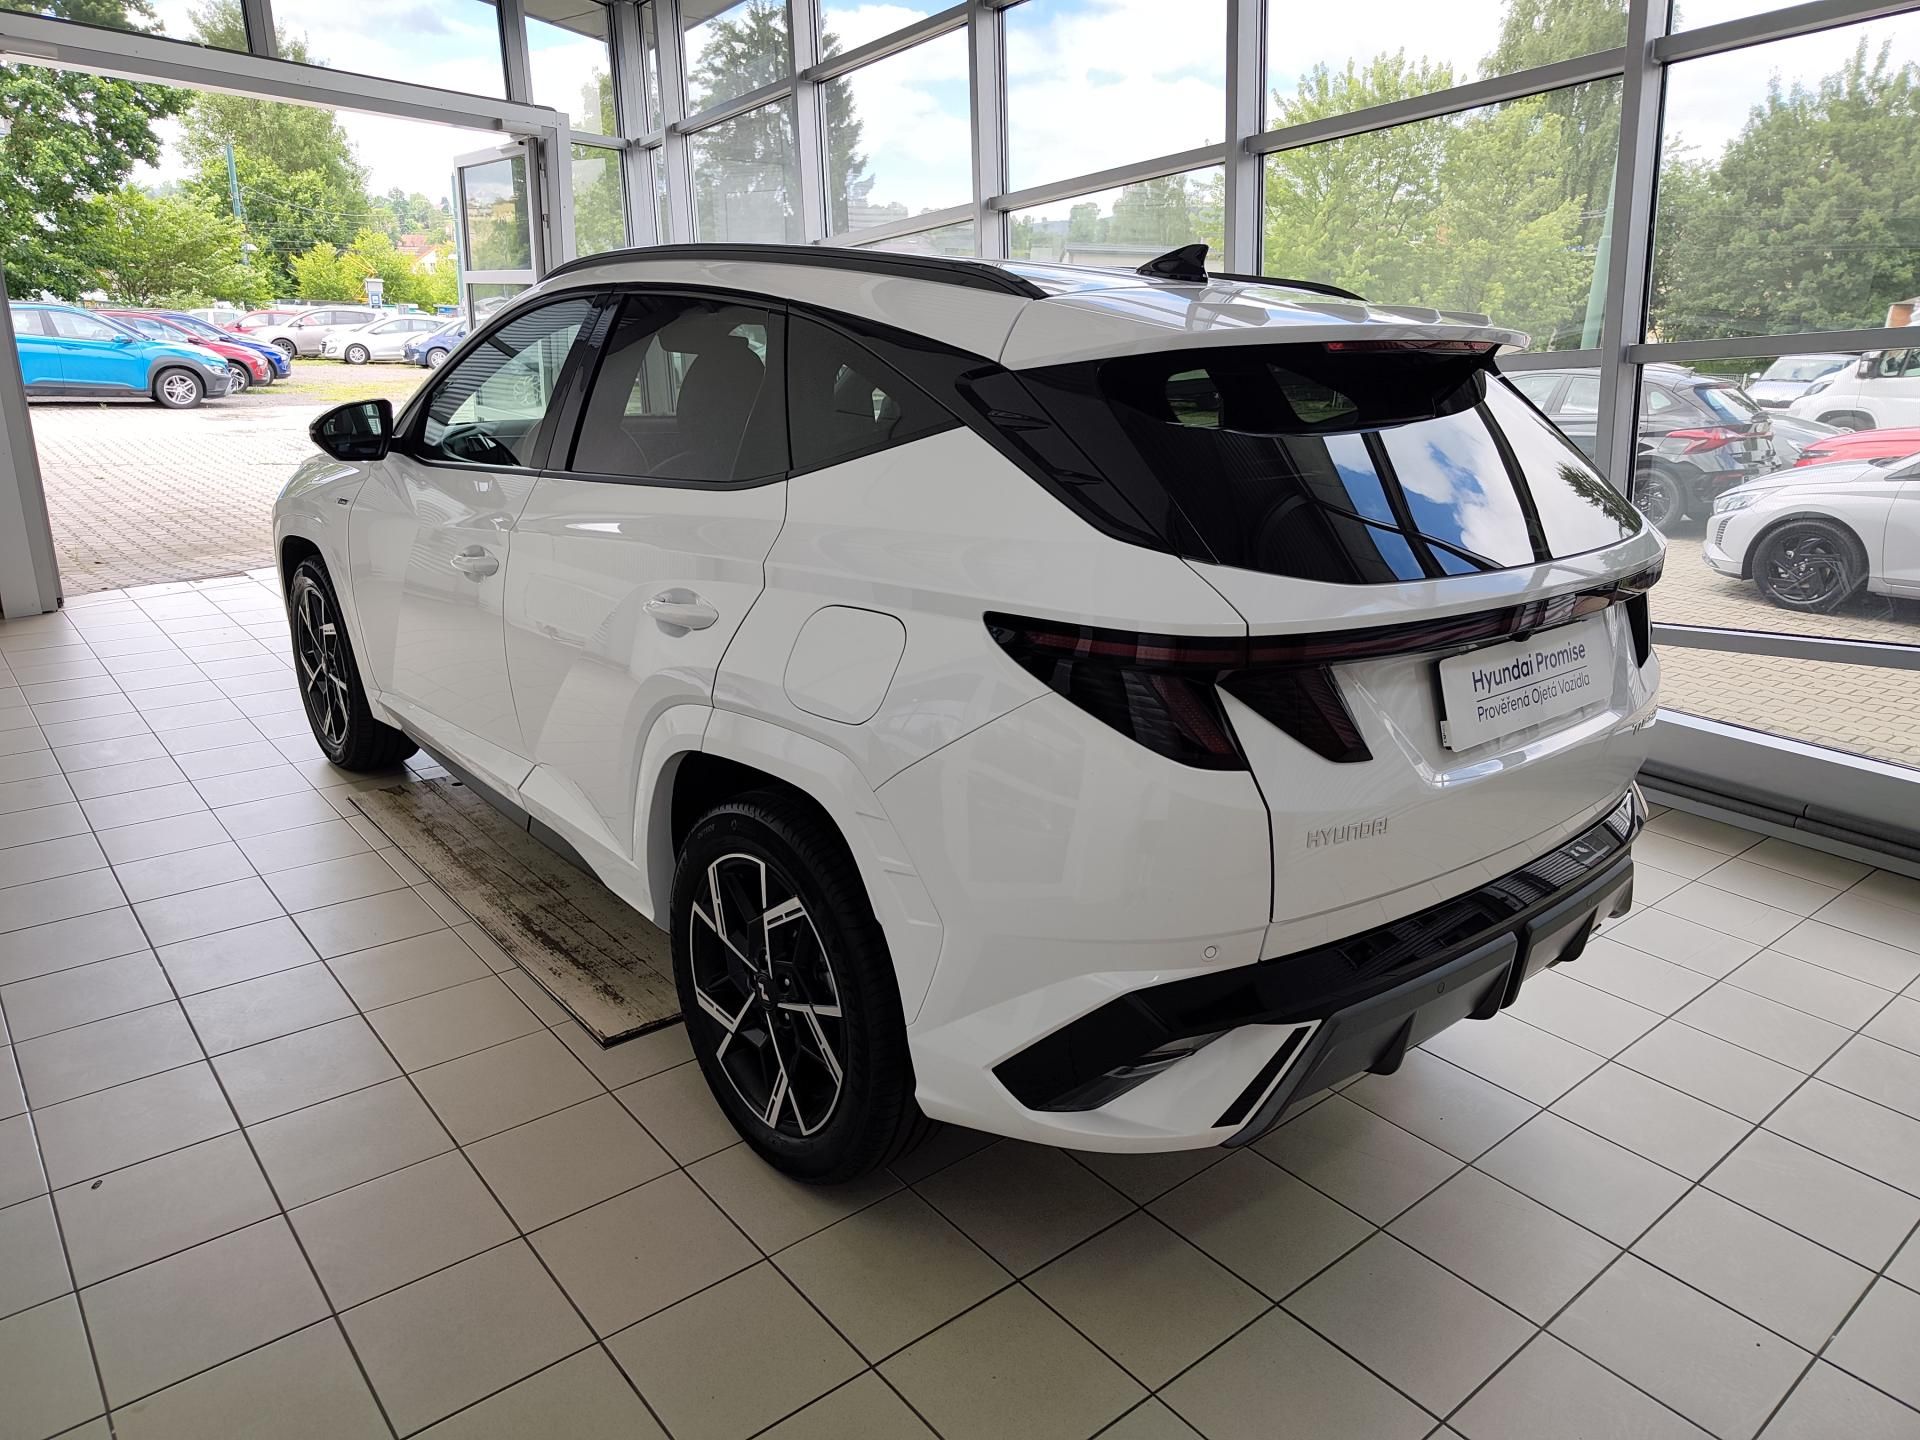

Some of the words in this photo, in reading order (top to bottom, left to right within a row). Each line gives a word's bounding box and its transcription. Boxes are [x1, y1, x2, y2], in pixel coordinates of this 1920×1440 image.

[1472, 653, 1534, 693] Hyundai
[1536, 641, 1586, 673] Promise
[1477, 690, 1530, 722] Prověřená
[1532, 681, 1558, 705] Ojetá
[1558, 671, 1590, 694] Vozidla
[1306, 817, 1388, 848] HYUNDAI
